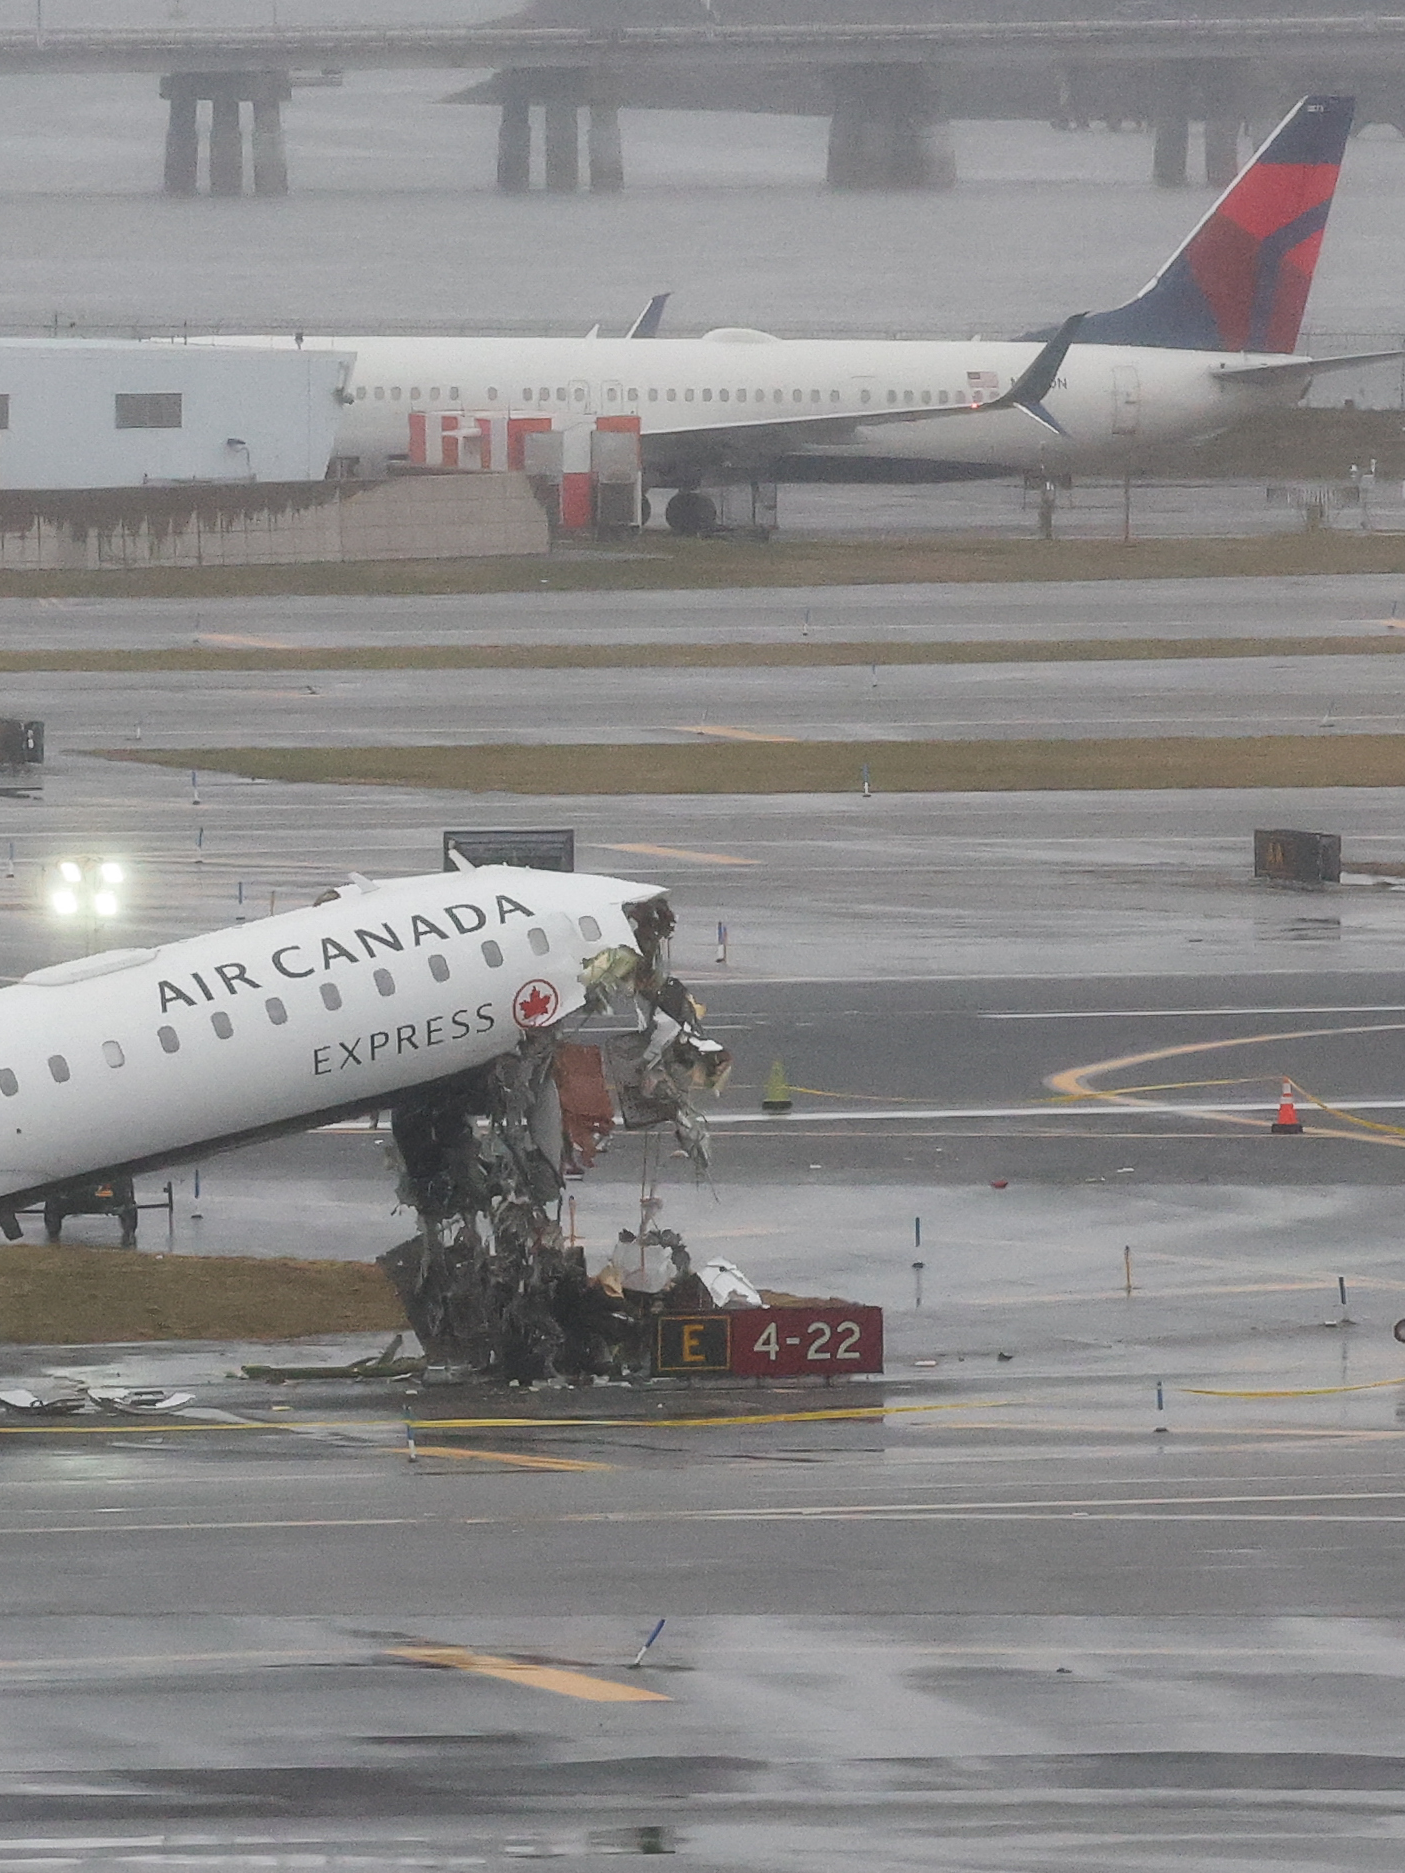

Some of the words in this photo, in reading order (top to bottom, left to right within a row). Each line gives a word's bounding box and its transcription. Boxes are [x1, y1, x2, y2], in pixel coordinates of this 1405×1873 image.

[157, 961, 263, 1014] AIR
[271, 893, 535, 979] CANADA
[313, 1002, 496, 1076] EXPRESS
[682, 1323, 706, 1362] E
[753, 1320, 862, 1361] 4-22
